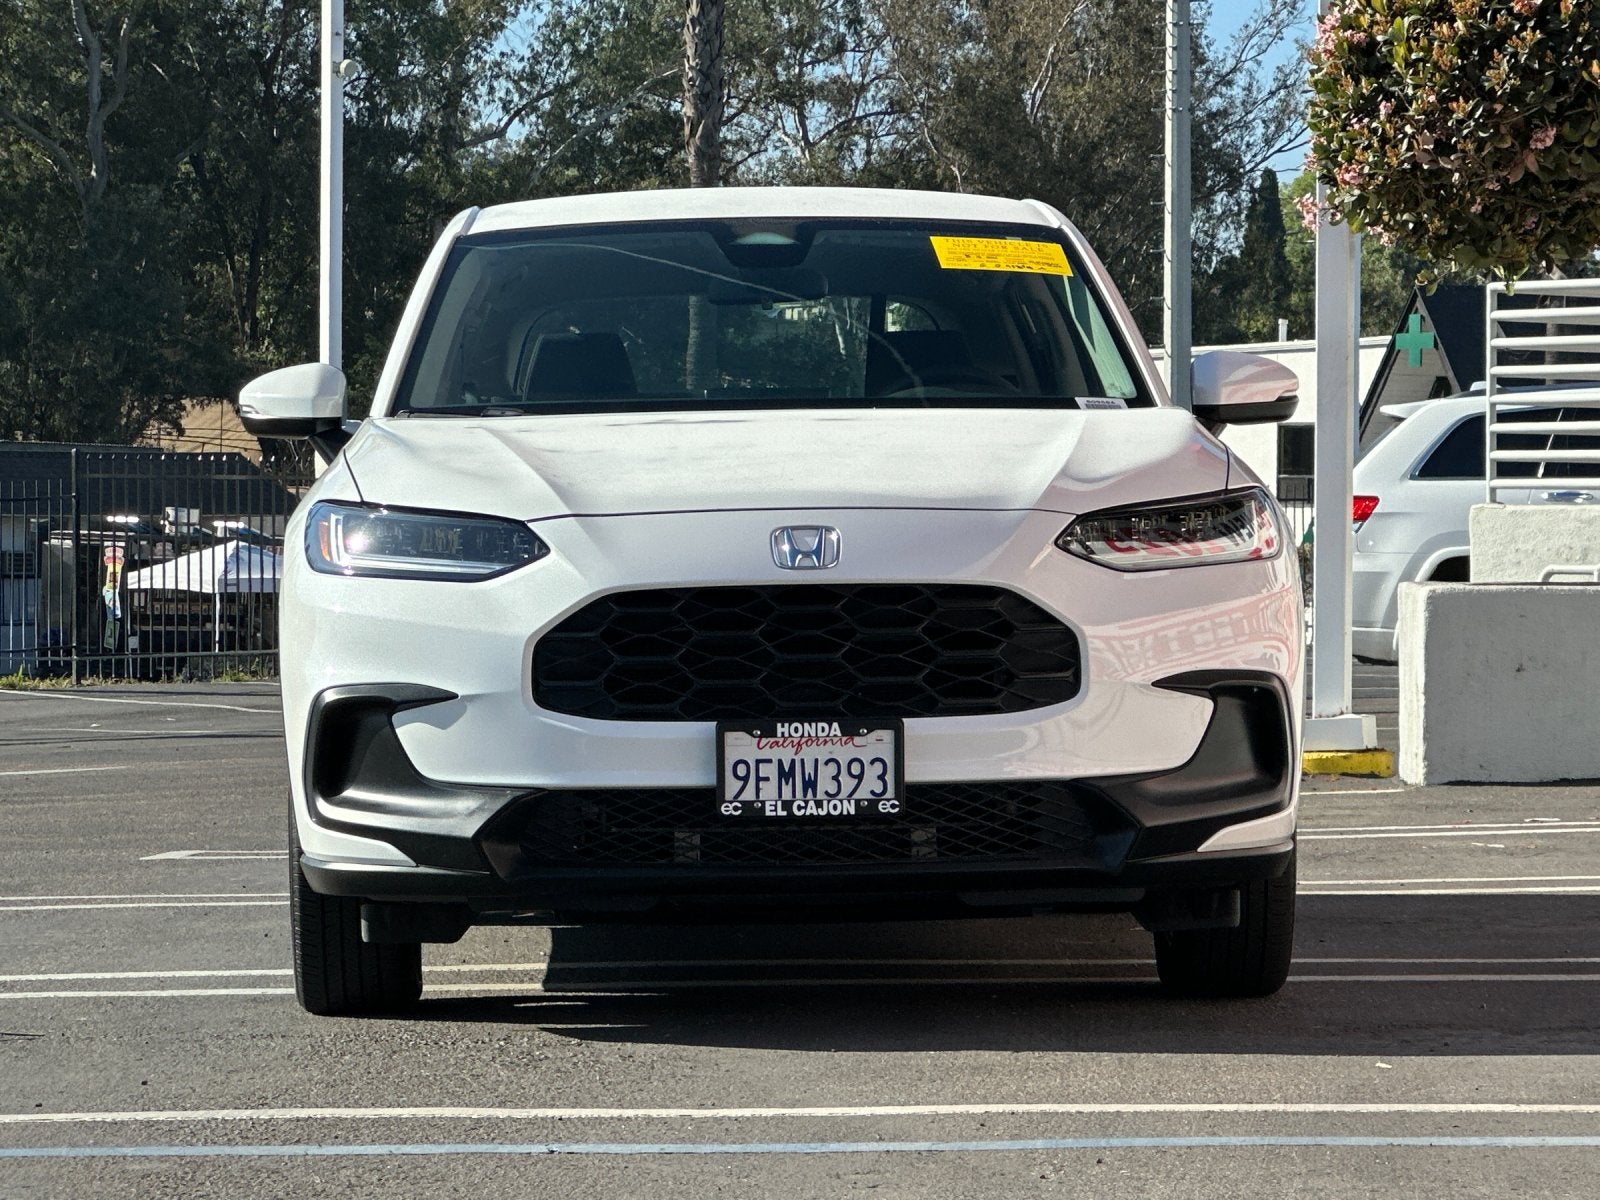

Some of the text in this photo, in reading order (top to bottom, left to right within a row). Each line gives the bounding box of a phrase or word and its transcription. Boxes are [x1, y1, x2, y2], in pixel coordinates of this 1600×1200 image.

[776, 722, 842, 737] HONDA
[757, 736, 867, 755] California
[732, 757, 888, 800] 9FMW393
[765, 800, 855, 816] EL CAJON
